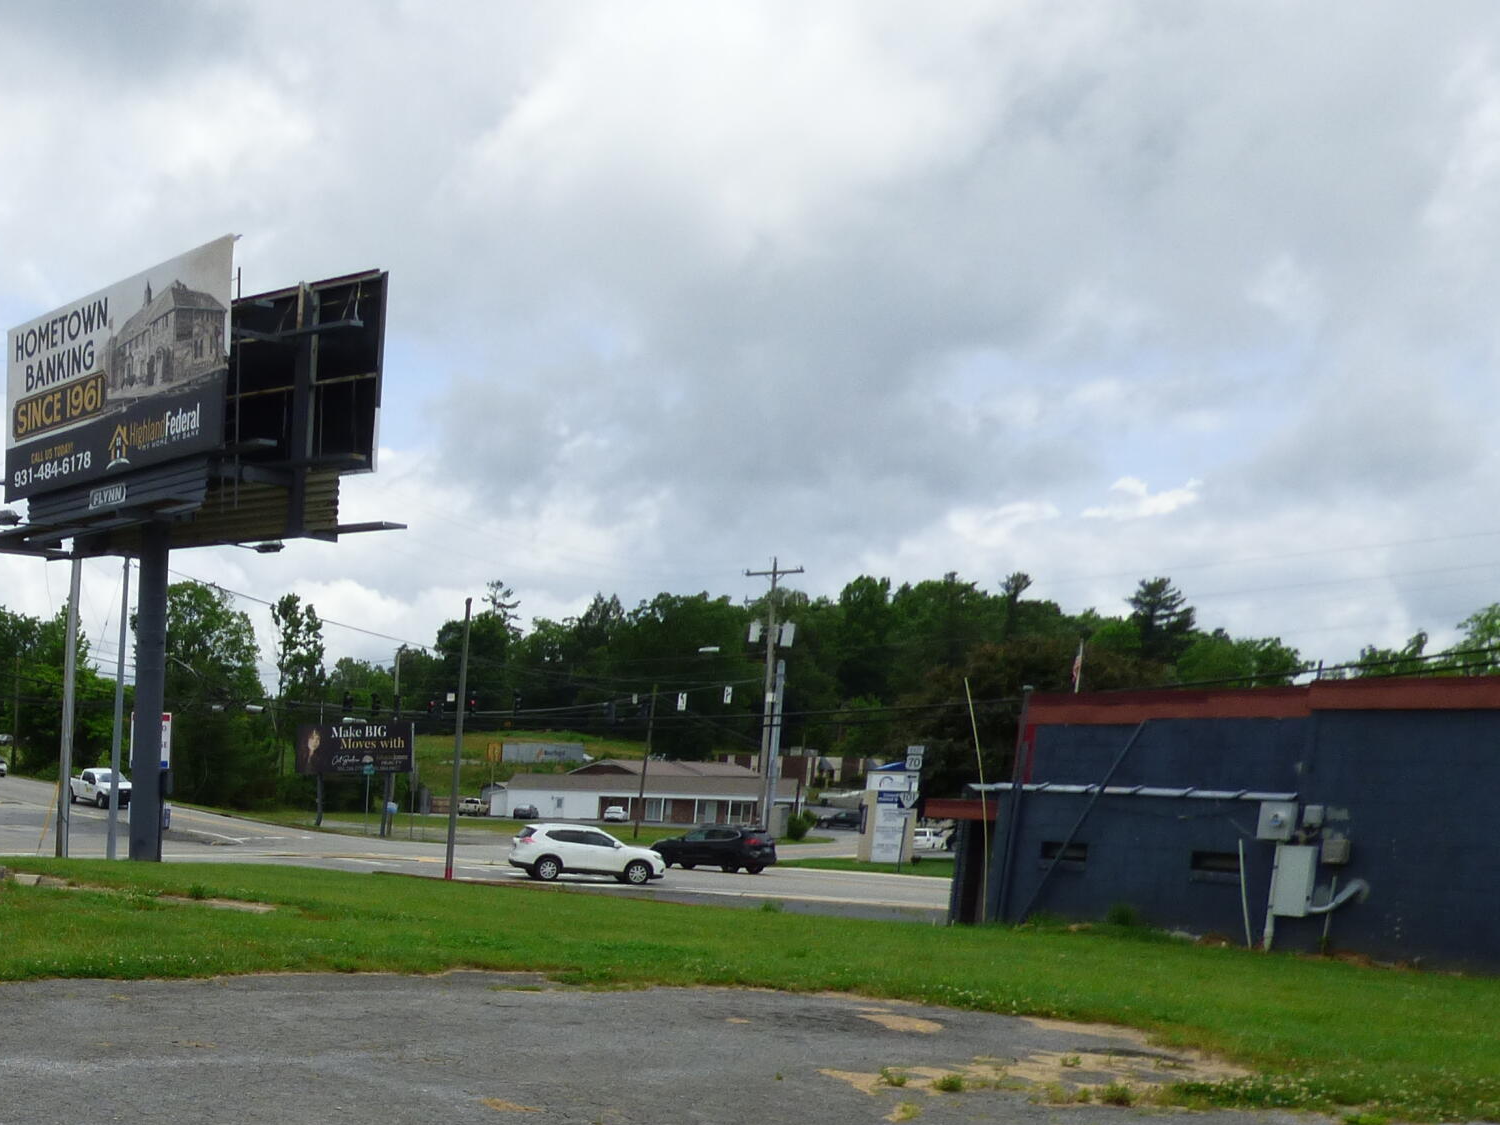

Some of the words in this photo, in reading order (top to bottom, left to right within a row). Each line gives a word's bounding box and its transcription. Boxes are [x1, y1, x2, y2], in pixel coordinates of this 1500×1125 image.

[15, 296, 109, 363] HOMETOWN
[25, 340, 95, 393] BANKING
[16, 391, 62, 434] SINCE
[66, 377, 102, 419] 1961
[14, 450, 91, 488] 931-484-6178
[31, 450, 44, 465] CALL
[331, 725, 362, 738] Make
[365, 725, 387, 738] BIG
[340, 738, 376, 750] Moves
[380, 736, 405, 749] with
[908, 756, 920, 768] 70
